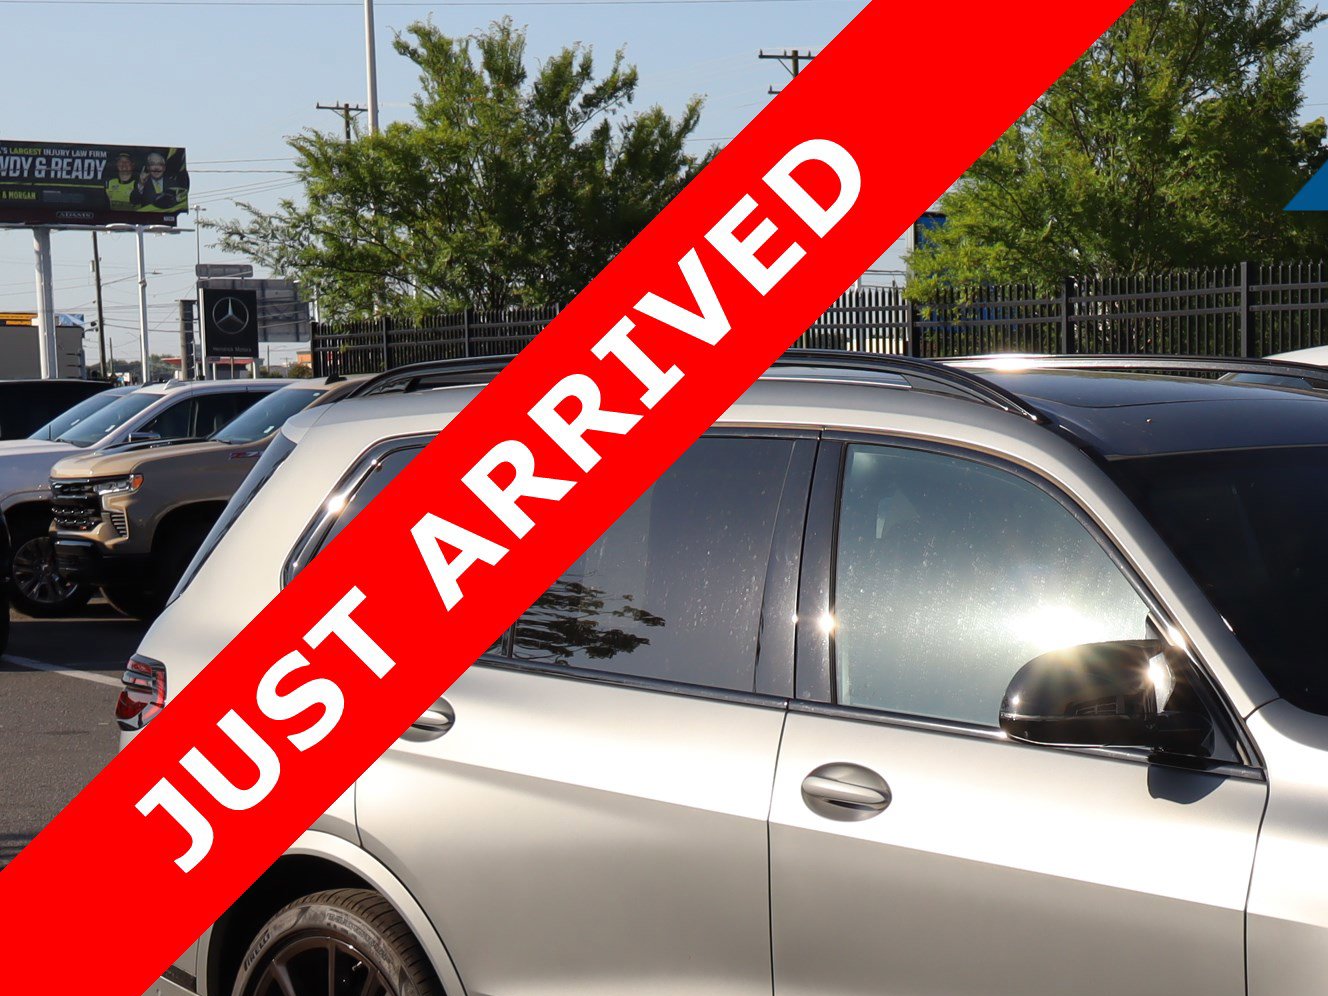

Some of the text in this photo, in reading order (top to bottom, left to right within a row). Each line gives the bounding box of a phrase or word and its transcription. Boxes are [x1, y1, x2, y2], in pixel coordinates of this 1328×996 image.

[9, 147, 42, 156] LARGEST
[43, 149, 70, 157] INJURY
[71, 150, 88, 158] LAW
[88, 150, 107, 159] FIRM
[35, 157, 49, 179] &
[50, 158, 107, 181] READY
[8, 190, 37, 200] MORGAN
